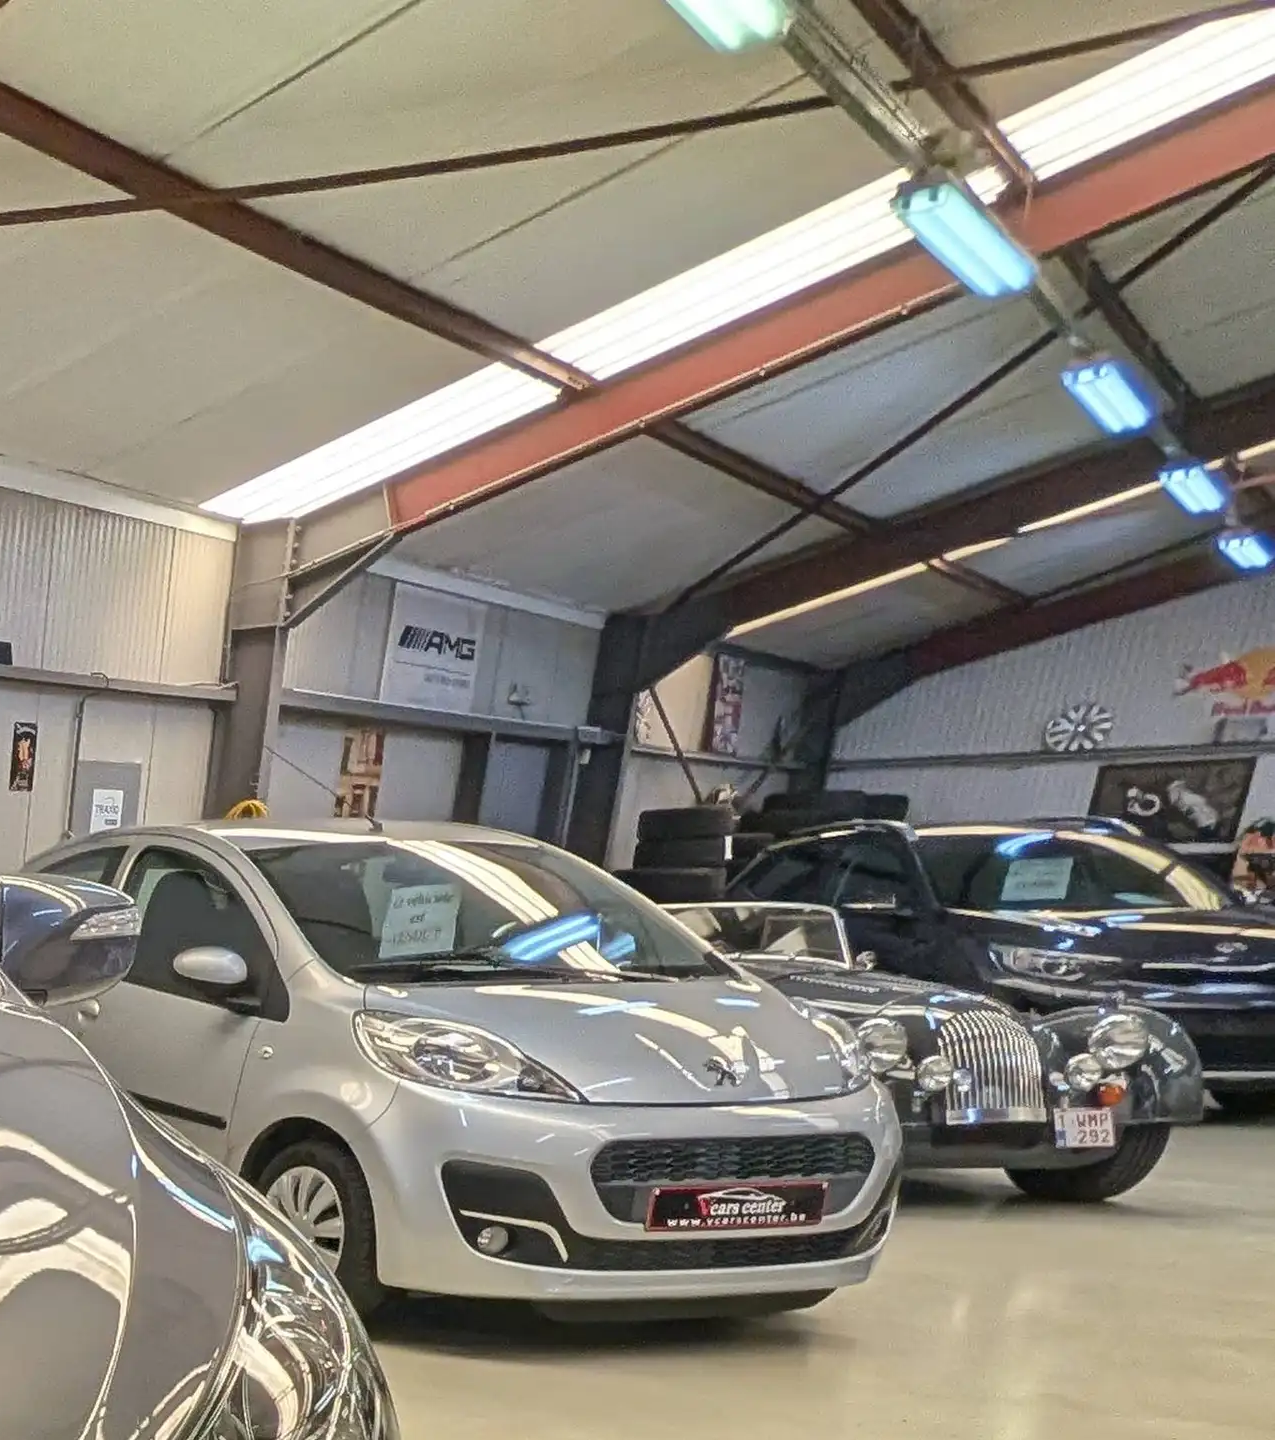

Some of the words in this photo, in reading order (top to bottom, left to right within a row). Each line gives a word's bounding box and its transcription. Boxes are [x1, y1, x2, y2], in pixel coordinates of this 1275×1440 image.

[1076, 1112, 1108, 1128] WMP
[1077, 1129, 1110, 1144] 292
[742, 1200, 786, 1215] center
[666, 1212, 807, 1227] www.vcarscenter.be
